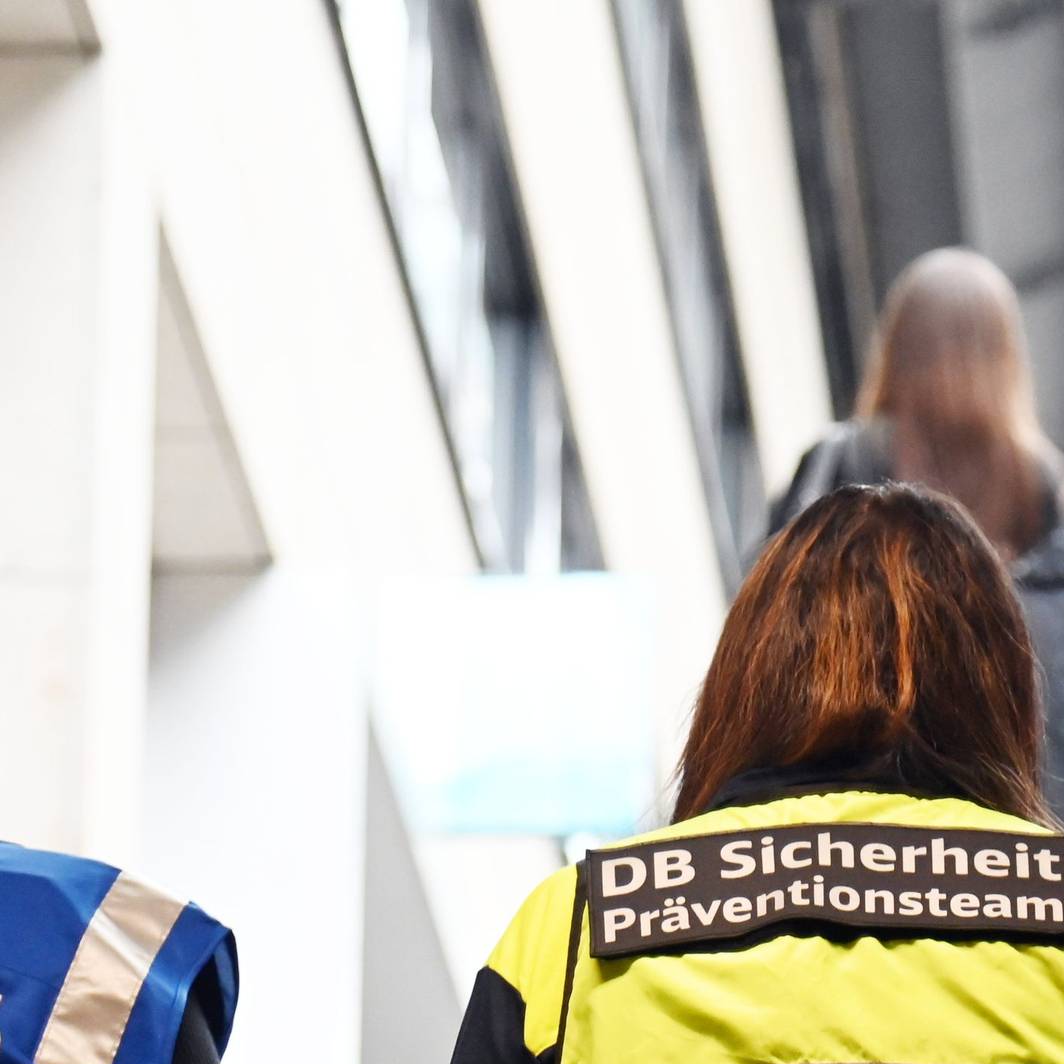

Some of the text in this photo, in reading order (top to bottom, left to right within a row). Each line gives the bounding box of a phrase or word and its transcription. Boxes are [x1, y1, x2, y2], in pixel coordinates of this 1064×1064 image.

[601, 831, 1062, 898] DB Sicherheit
[603, 875, 1064, 944] Präventionsteam
